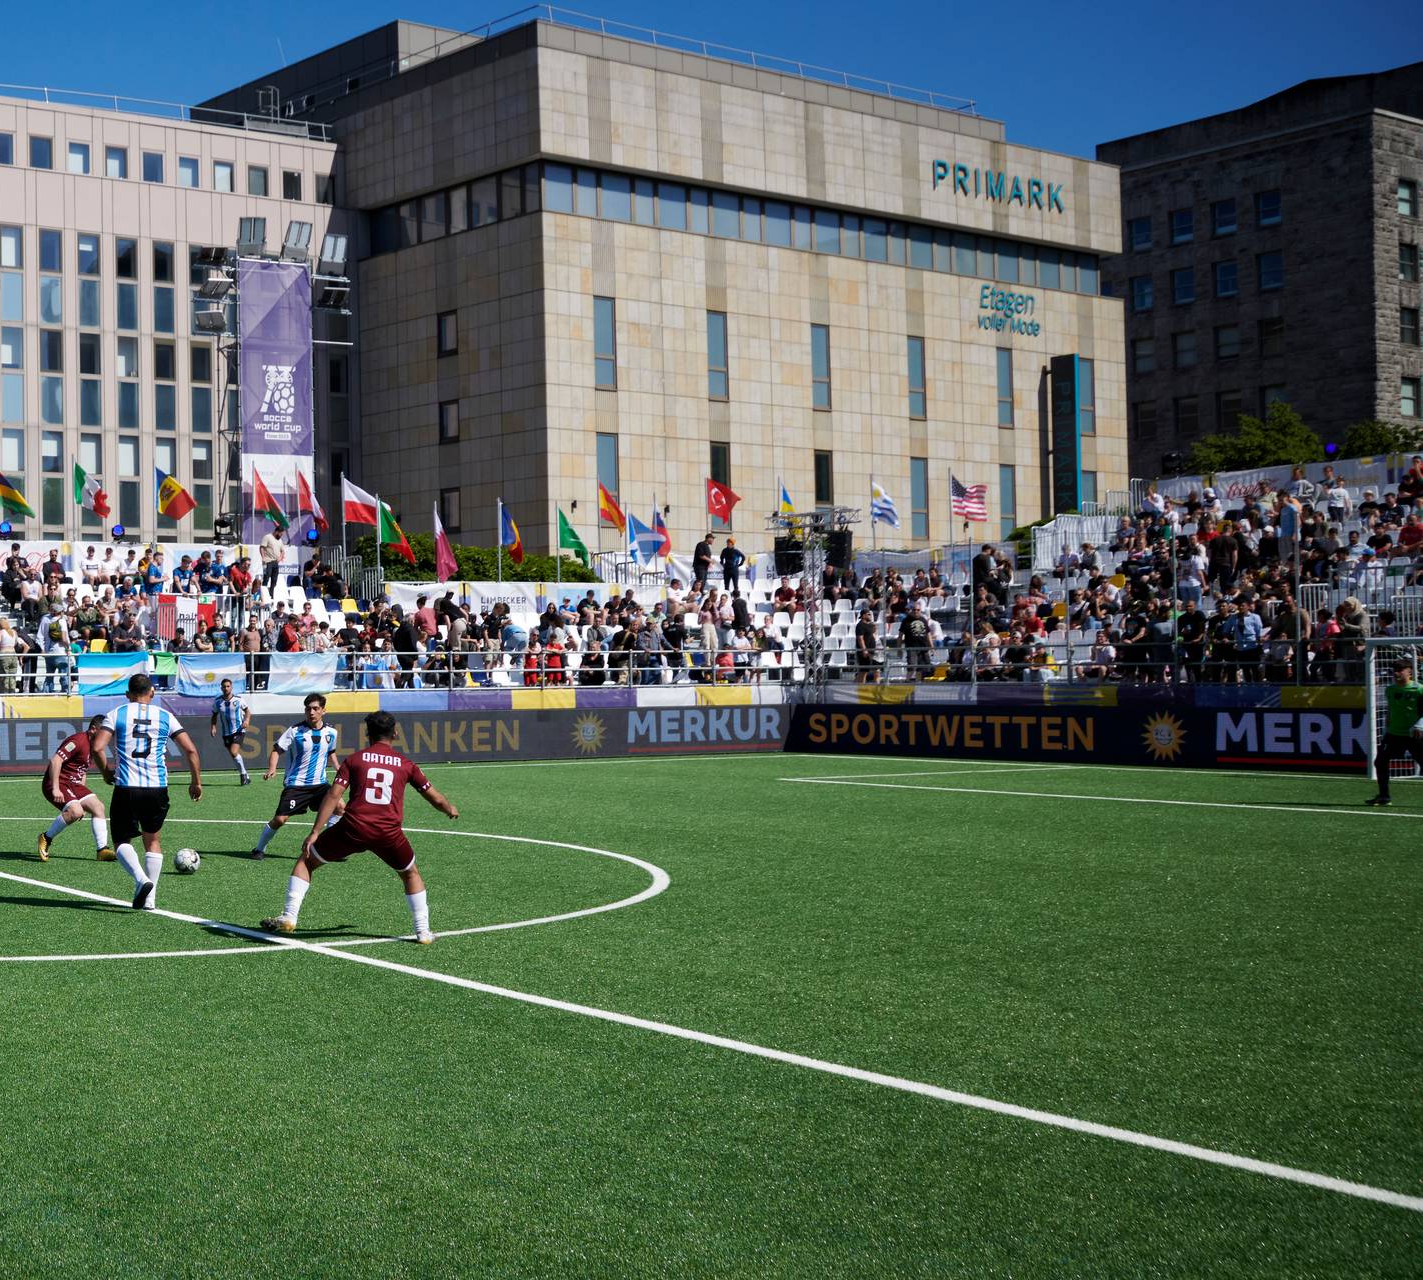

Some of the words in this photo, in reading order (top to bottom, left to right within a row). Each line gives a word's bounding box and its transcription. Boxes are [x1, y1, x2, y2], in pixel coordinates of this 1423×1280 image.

[933, 160, 1064, 214] PRIMARK
[979, 284, 1036, 318] Etagen
[977, 313, 1007, 332] voller
[1010, 319, 1041, 337] Mode
[254, 422, 280, 431] world
[283, 424, 302, 433] cup
[1055, 381, 1073, 507] PRIMARK
[131, 719, 152, 759] 5
[627, 709, 781, 743] MERKUR
[808, 713, 1094, 752] SPORTWETTEN
[1215, 711, 1369, 755] MERK
[362, 752, 401, 767] QATAR
[289, 799, 296, 809] 9
[365, 767, 394, 805] 3
